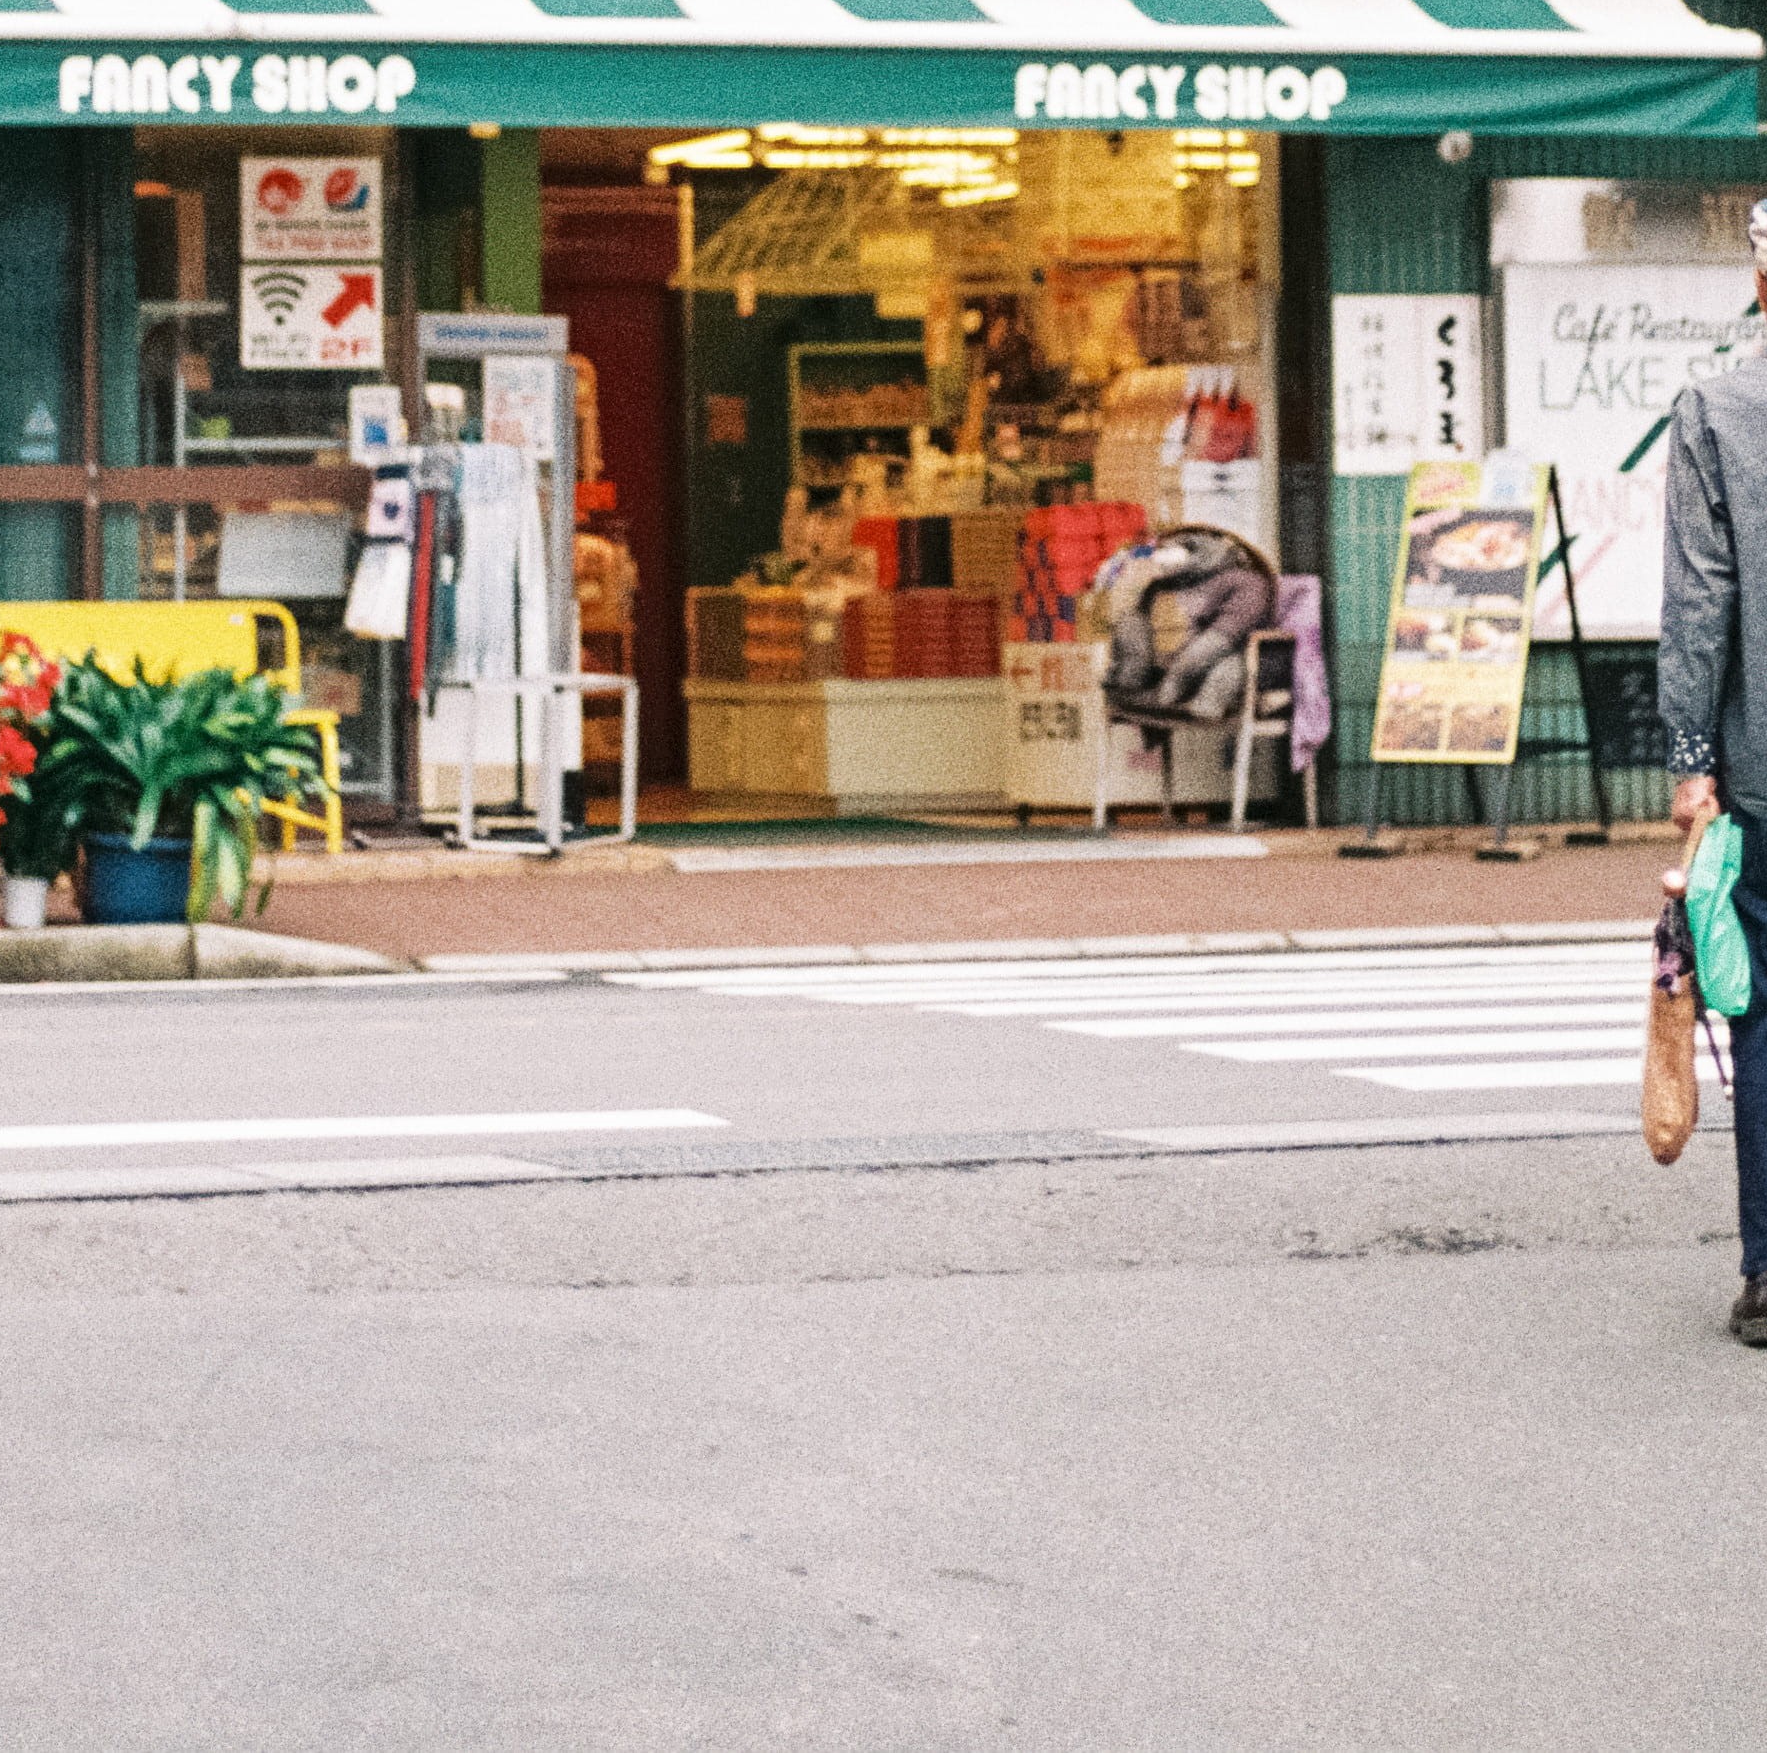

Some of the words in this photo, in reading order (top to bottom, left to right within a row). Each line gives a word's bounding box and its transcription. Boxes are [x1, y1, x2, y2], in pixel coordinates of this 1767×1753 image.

[59, 54, 242, 114] FANCY
[252, 54, 416, 114] SHOP
[1015, 62, 1186, 120] FANCY
[1194, 63, 1347, 122] SHOP
